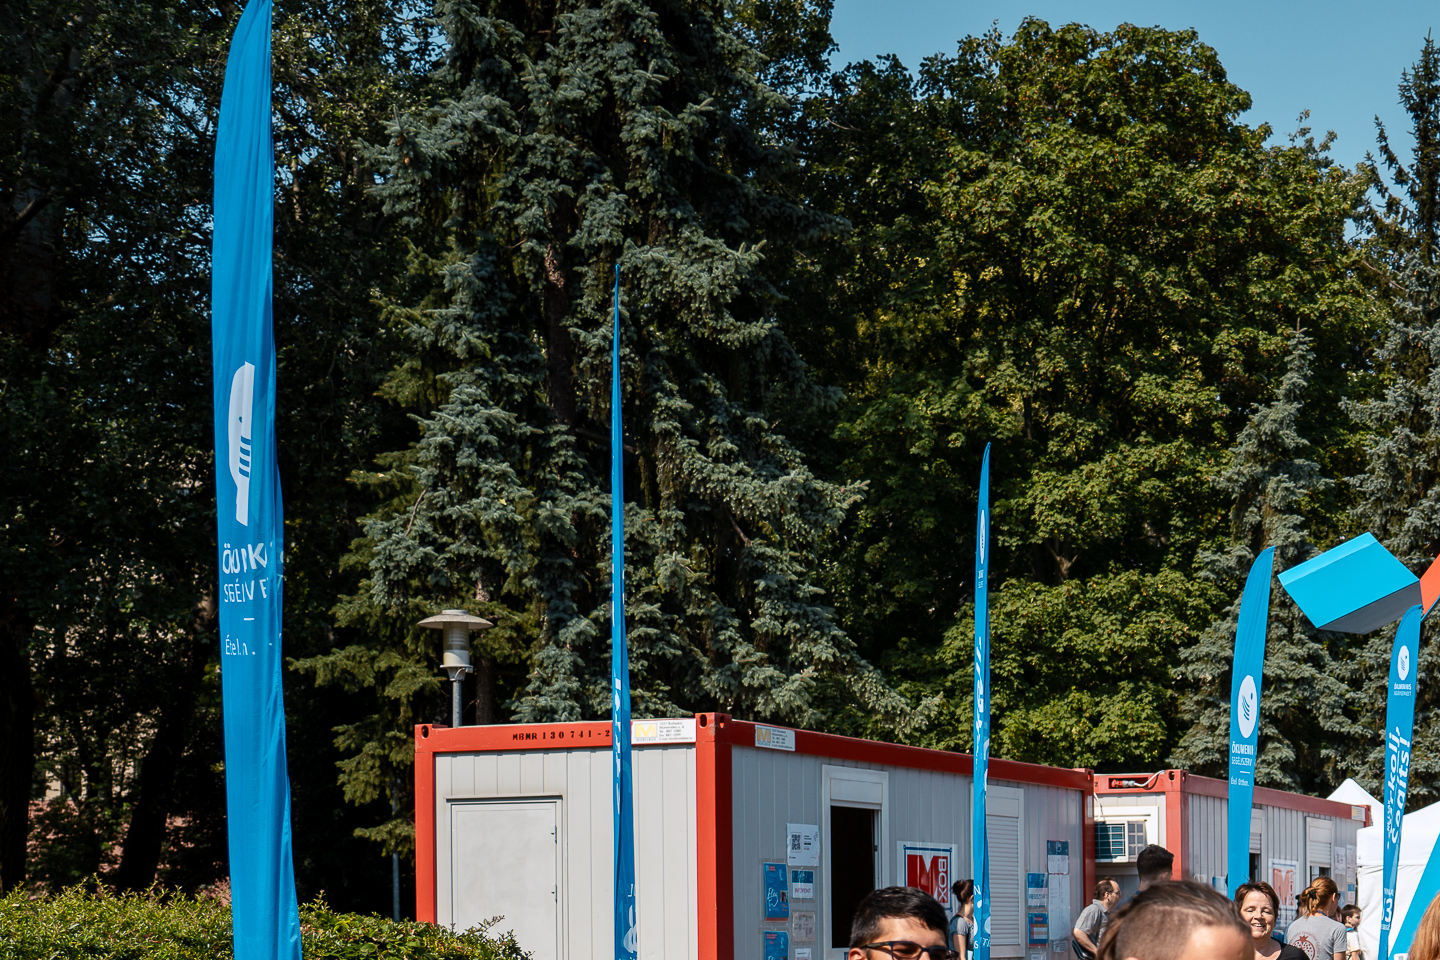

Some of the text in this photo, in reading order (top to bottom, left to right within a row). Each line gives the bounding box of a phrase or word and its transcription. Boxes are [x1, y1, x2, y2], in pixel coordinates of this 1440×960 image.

[512, 732, 538, 741] MBMR
[542, 731, 565, 740] 130
[938, 858, 947, 902] BOX
